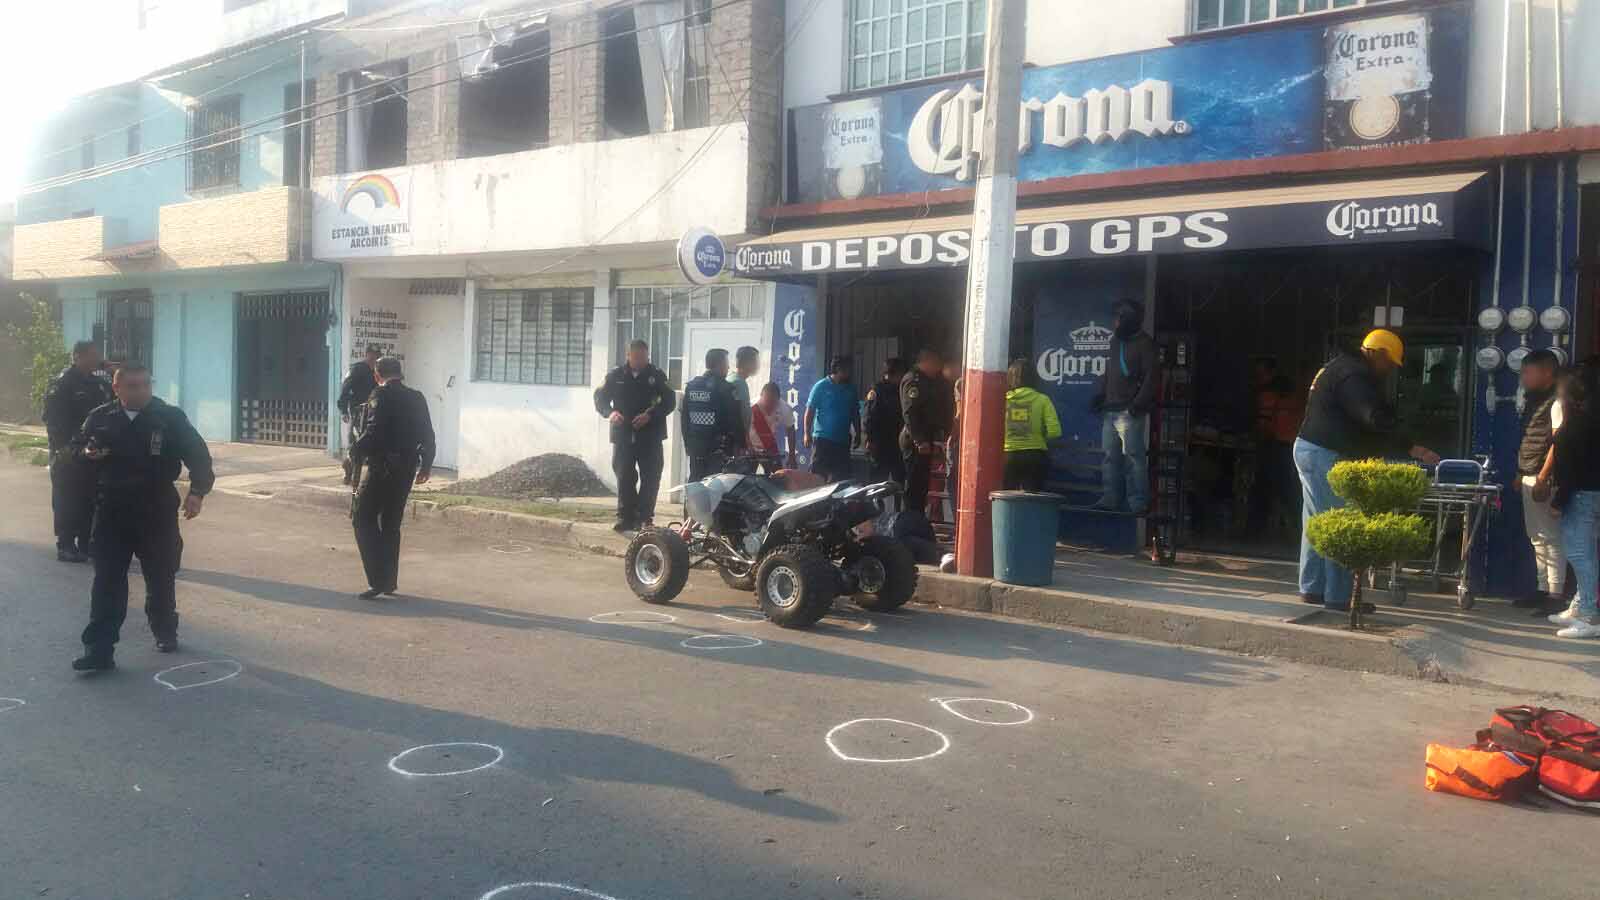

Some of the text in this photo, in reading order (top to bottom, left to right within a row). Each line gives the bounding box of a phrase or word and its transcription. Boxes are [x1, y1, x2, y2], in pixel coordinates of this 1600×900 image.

[1336, 30, 1418, 60] Corona
[1356, 55, 1405, 71] Extra
[831, 114, 874, 137] Corona
[840, 134, 868, 147] Extra
[1326, 200, 1440, 239] Corona
[331, 223, 410, 240] ESTANCIA INFANTIL
[350, 235, 388, 249] ARCOIRIS
[1090, 211, 1229, 254] GPS
[735, 246, 792, 273] Corona
